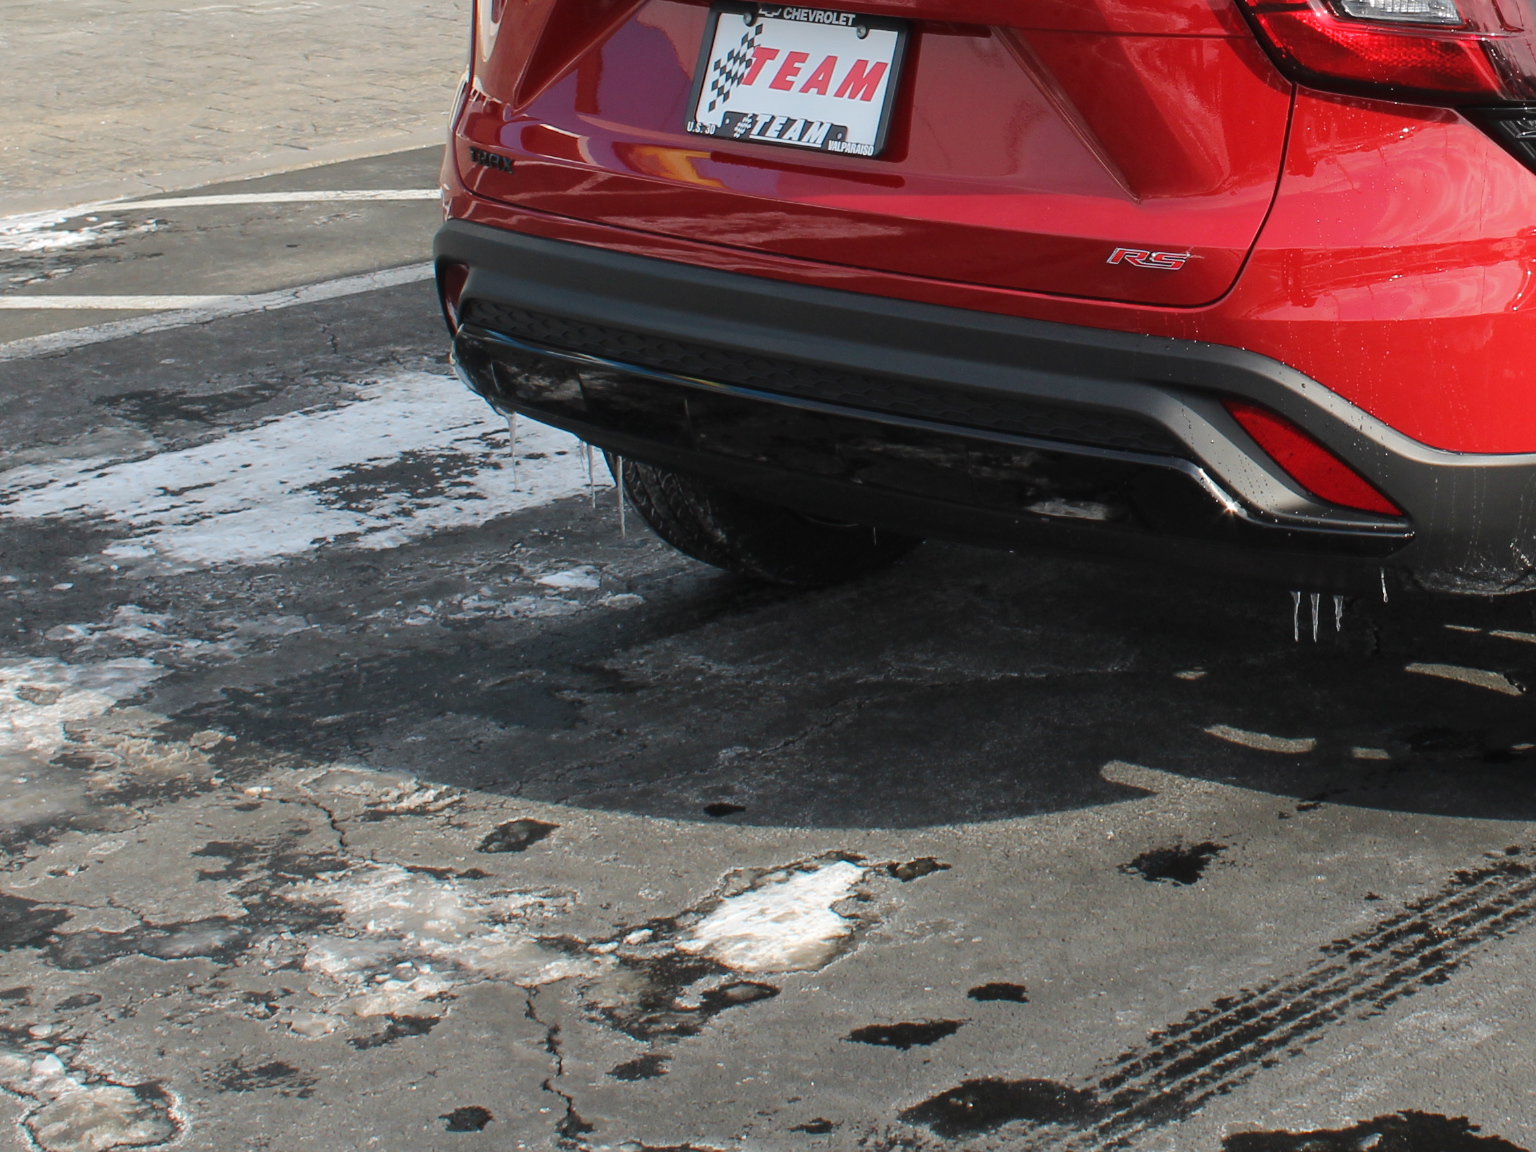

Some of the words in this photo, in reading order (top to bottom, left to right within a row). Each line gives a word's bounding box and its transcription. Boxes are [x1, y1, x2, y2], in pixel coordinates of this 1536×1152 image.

[783, 7, 856, 27] CHEVROLET
[742, 46, 888, 102] TEAM
[686, 121, 703, 134] U.S.
[705, 123, 716, 136] 30
[750, 114, 832, 146] TEAM
[828, 139, 874, 157] VALPARAISO
[1106, 247, 1191, 270] RS
